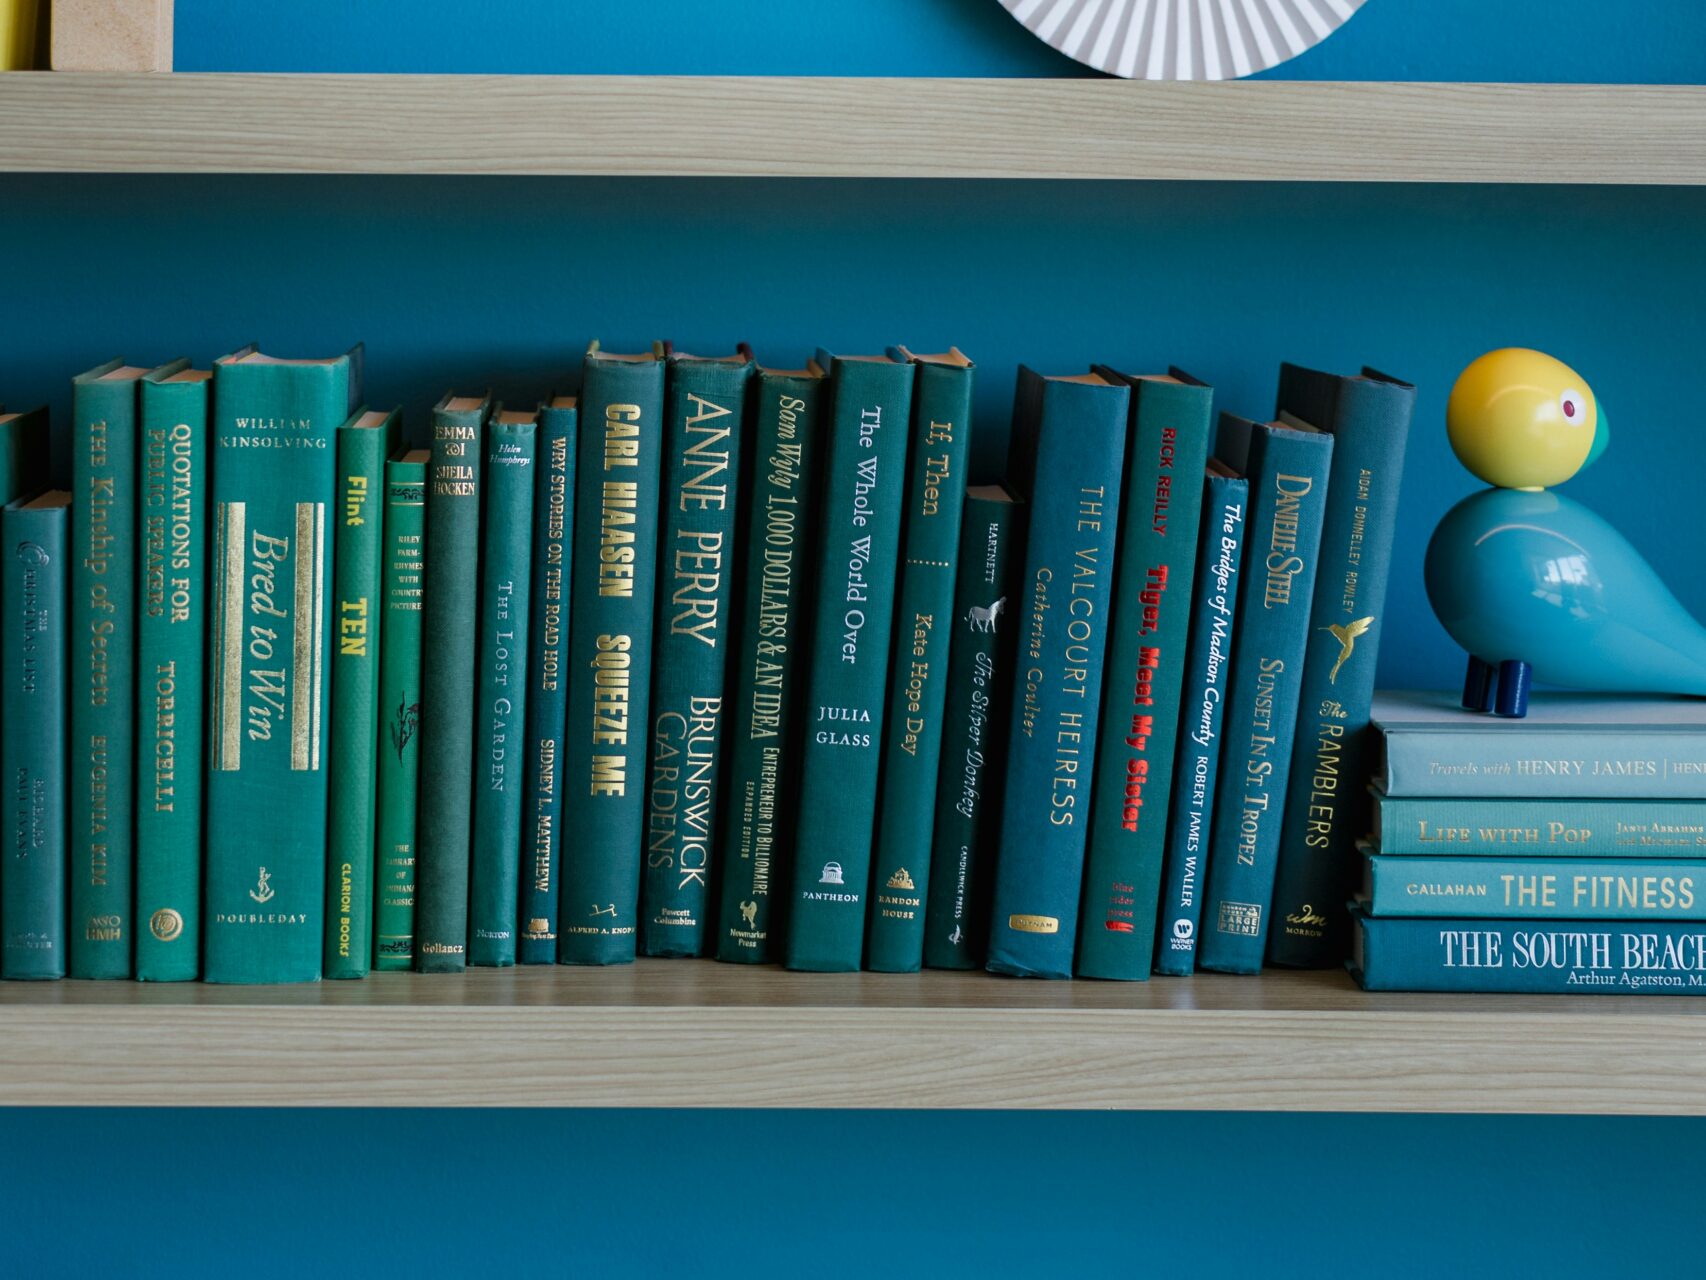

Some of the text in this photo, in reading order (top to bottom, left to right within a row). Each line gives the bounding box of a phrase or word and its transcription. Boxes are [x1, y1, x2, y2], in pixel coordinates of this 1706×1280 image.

[220, 436, 326, 449] KINSOLVING
[235, 417, 311, 431] WILLIAM
[433, 482, 476, 496] HOCKEN
[434, 426, 476, 440] EMMA
[436, 466, 474, 480] SHEILA
[923, 421, 952, 515] If, Then
[1153, 428, 1176, 537] RICK REILLY
[84, 419, 115, 706] THE Kinship of Secrets
[146, 429, 166, 619] PUBLIC SPEAKERS
[169, 424, 191, 624] QUOTATIONS FOR
[346, 475, 368, 527] Flint
[543, 437, 566, 691] WRY STORIES ON THE ROAD HOLE
[598, 404, 641, 598] CARL HIAASEN
[671, 393, 732, 648] ANNE PERRY
[751, 395, 805, 739] Sam Wyly 1,000 DOLLARS & AN IDEA
[843, 406, 882, 664] The Whole World Over
[248, 529, 289, 742] Bred to Win
[341, 597, 367, 657] TEN
[491, 581, 513, 792] THE LOST GARDEN
[901, 614, 933, 756] Kate Hope Day
[1021, 568, 1052, 738] Catherine Coulter
[1050, 486, 1104, 825] THE VALCOURT HEIRESS
[155, 660, 176, 813] TORRICELLI
[591, 634, 632, 796] SQUEEZE ME
[816, 732, 870, 747] GLASS
[818, 706, 870, 722] JULIA
[1122, 564, 1169, 832] Tiger, Meet My Sister
[1181, 504, 1241, 907] The Bridges of Madison County ROBERT JAMES WALLER
[1237, 658, 1284, 866] SUNSET IN ST. TROPEZ
[1321, 700, 1347, 718] The
[535, 739, 555, 893] SIDNEY MATTHEW
[648, 712, 687, 869] GARDENS
[679, 695, 722, 890] BRUNSWICK
[752, 747, 780, 896] ENTREPRENEUR TO BILLIONAIRE
[1306, 722, 1344, 848] RAMBLERS
[1418, 821, 1470, 842] LIFE
[1480, 828, 1539, 842] WITH
[1548, 822, 1592, 843] POP
[1517, 760, 1657, 776] HENRY JAMES
[216, 913, 307, 924] DOUBLEDAY
[339, 863, 351, 958] CLARION BOOKS
[422, 943, 464, 954] Gollancz
[803, 892, 858, 902] PANTHEON
[1407, 875, 1695, 909] CALLAHAN THE FITNESS
[1440, 930, 1612, 969] THE SOUTH
[1567, 971, 1685, 989] Arthur Agatston,
